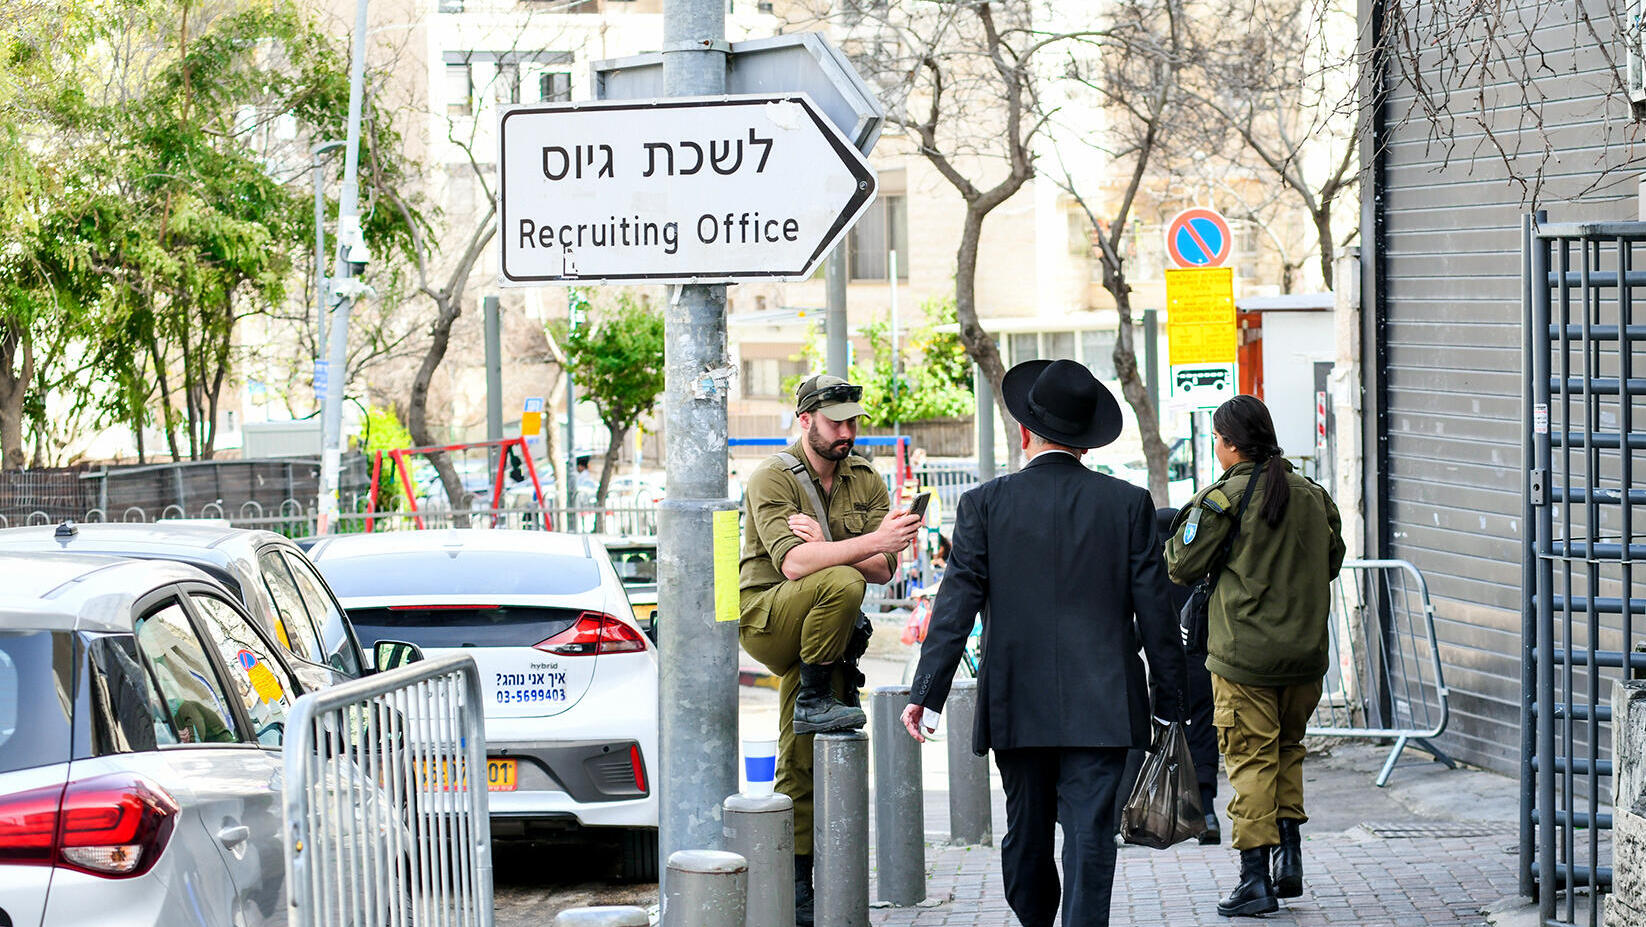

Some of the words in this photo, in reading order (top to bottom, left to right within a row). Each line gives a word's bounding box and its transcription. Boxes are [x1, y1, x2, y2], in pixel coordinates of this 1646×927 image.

[643, 128, 773, 177] לשכת
[543, 144, 614, 180] גיוס
[520, 216, 678, 254] Recruiting
[698, 212, 799, 245] Office
[531, 662, 559, 671] hybrid
[496, 673, 525, 686] נוהג?
[528, 672, 545, 685] אני
[548, 672, 566, 688] איך
[496, 688, 567, 704] 03-5699403
